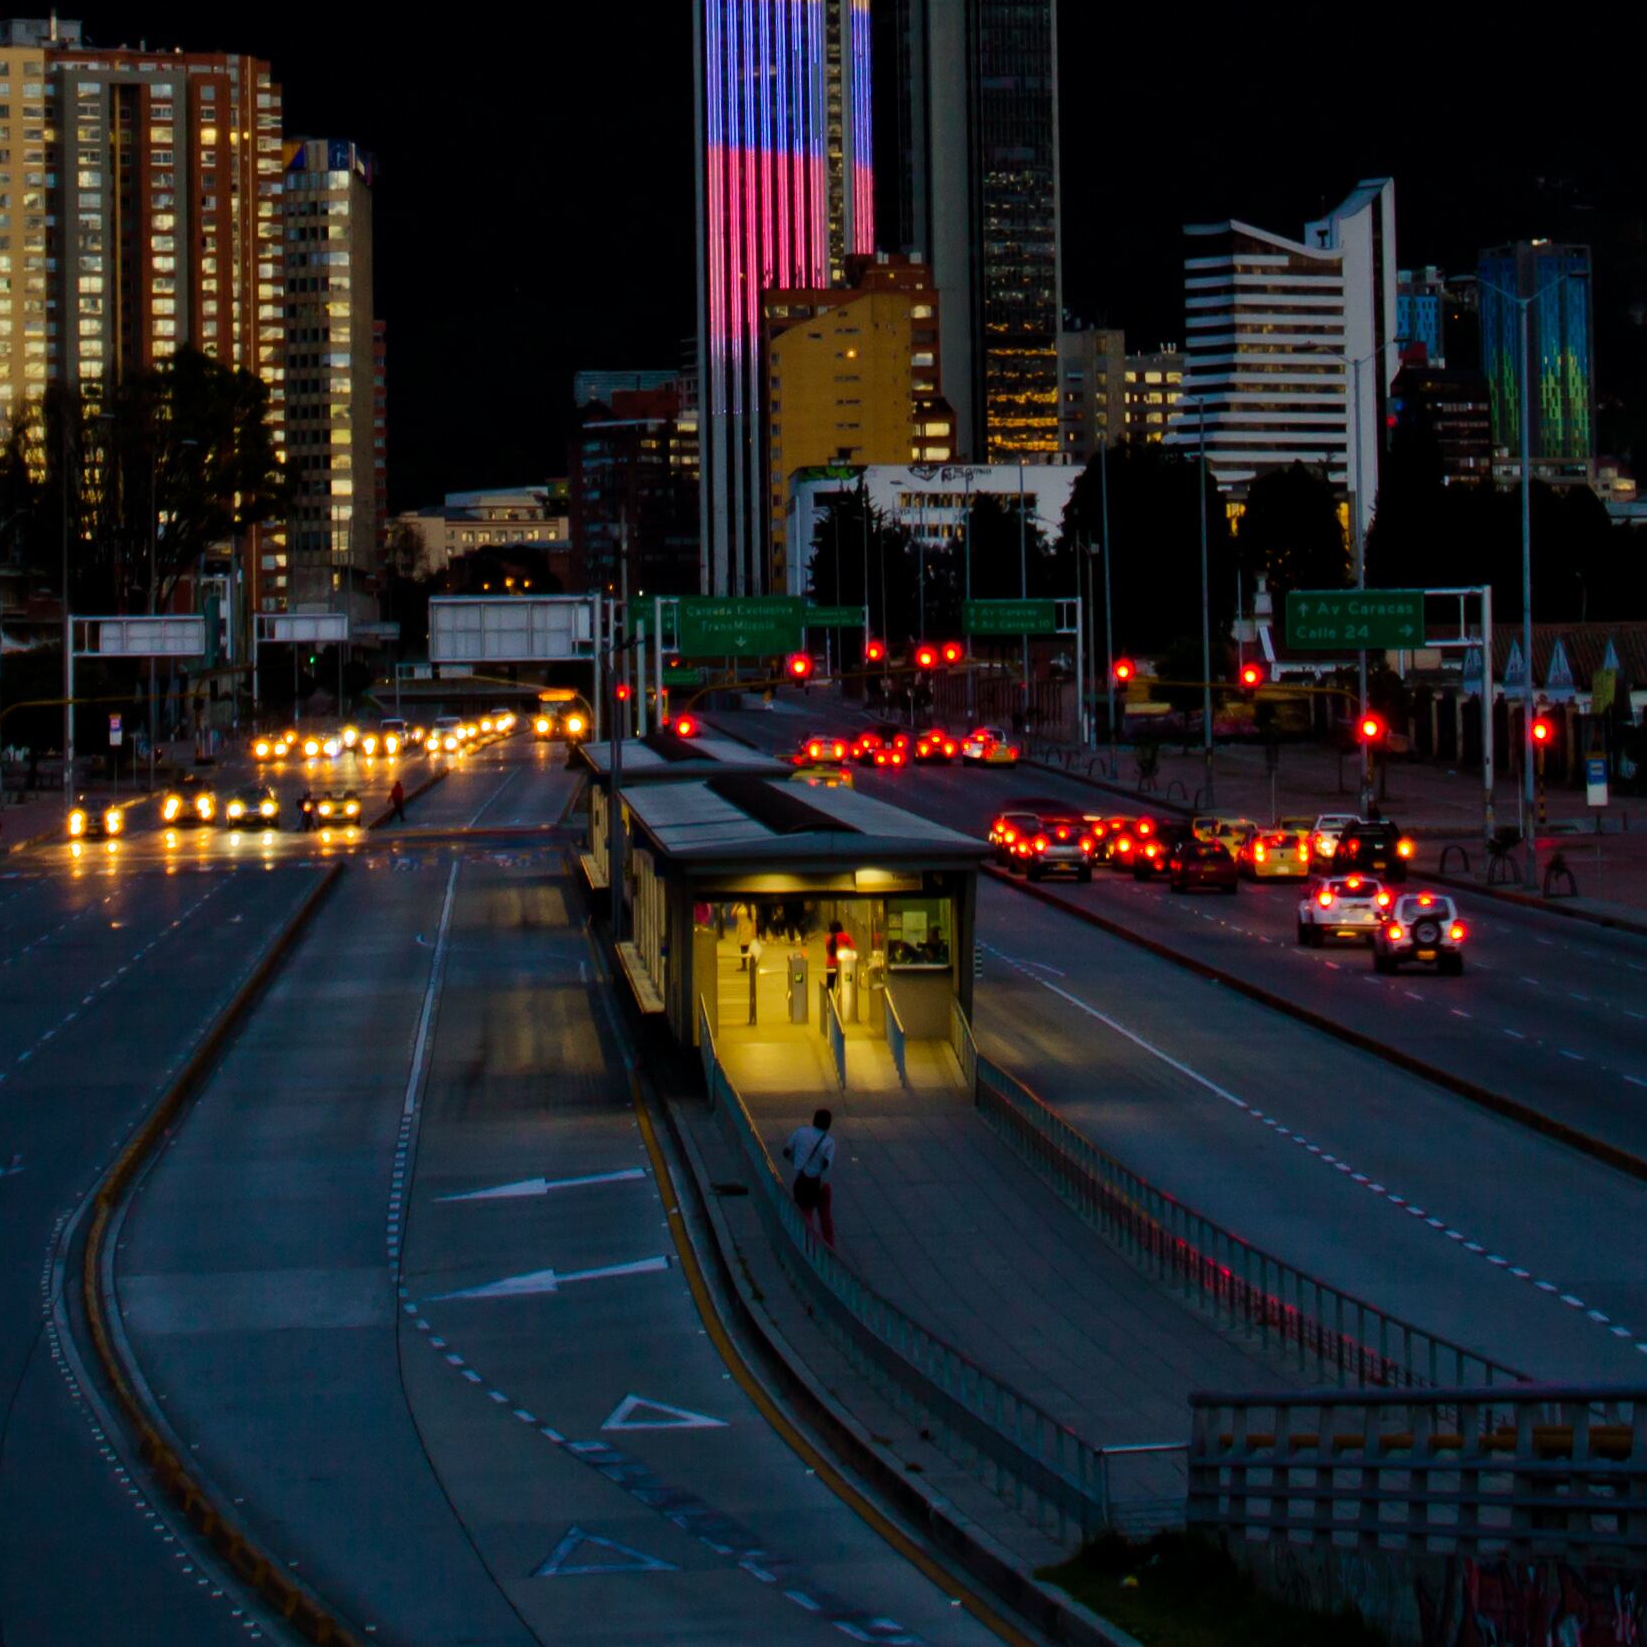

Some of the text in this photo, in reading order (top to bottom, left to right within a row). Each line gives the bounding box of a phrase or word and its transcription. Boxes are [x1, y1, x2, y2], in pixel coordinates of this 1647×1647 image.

[686, 605, 732, 617] Calzada
[737, 604, 793, 616] Exclusiva
[1317, 601, 1414, 615] Av Caracas
[1296, 625, 1368, 640] Calle 24
